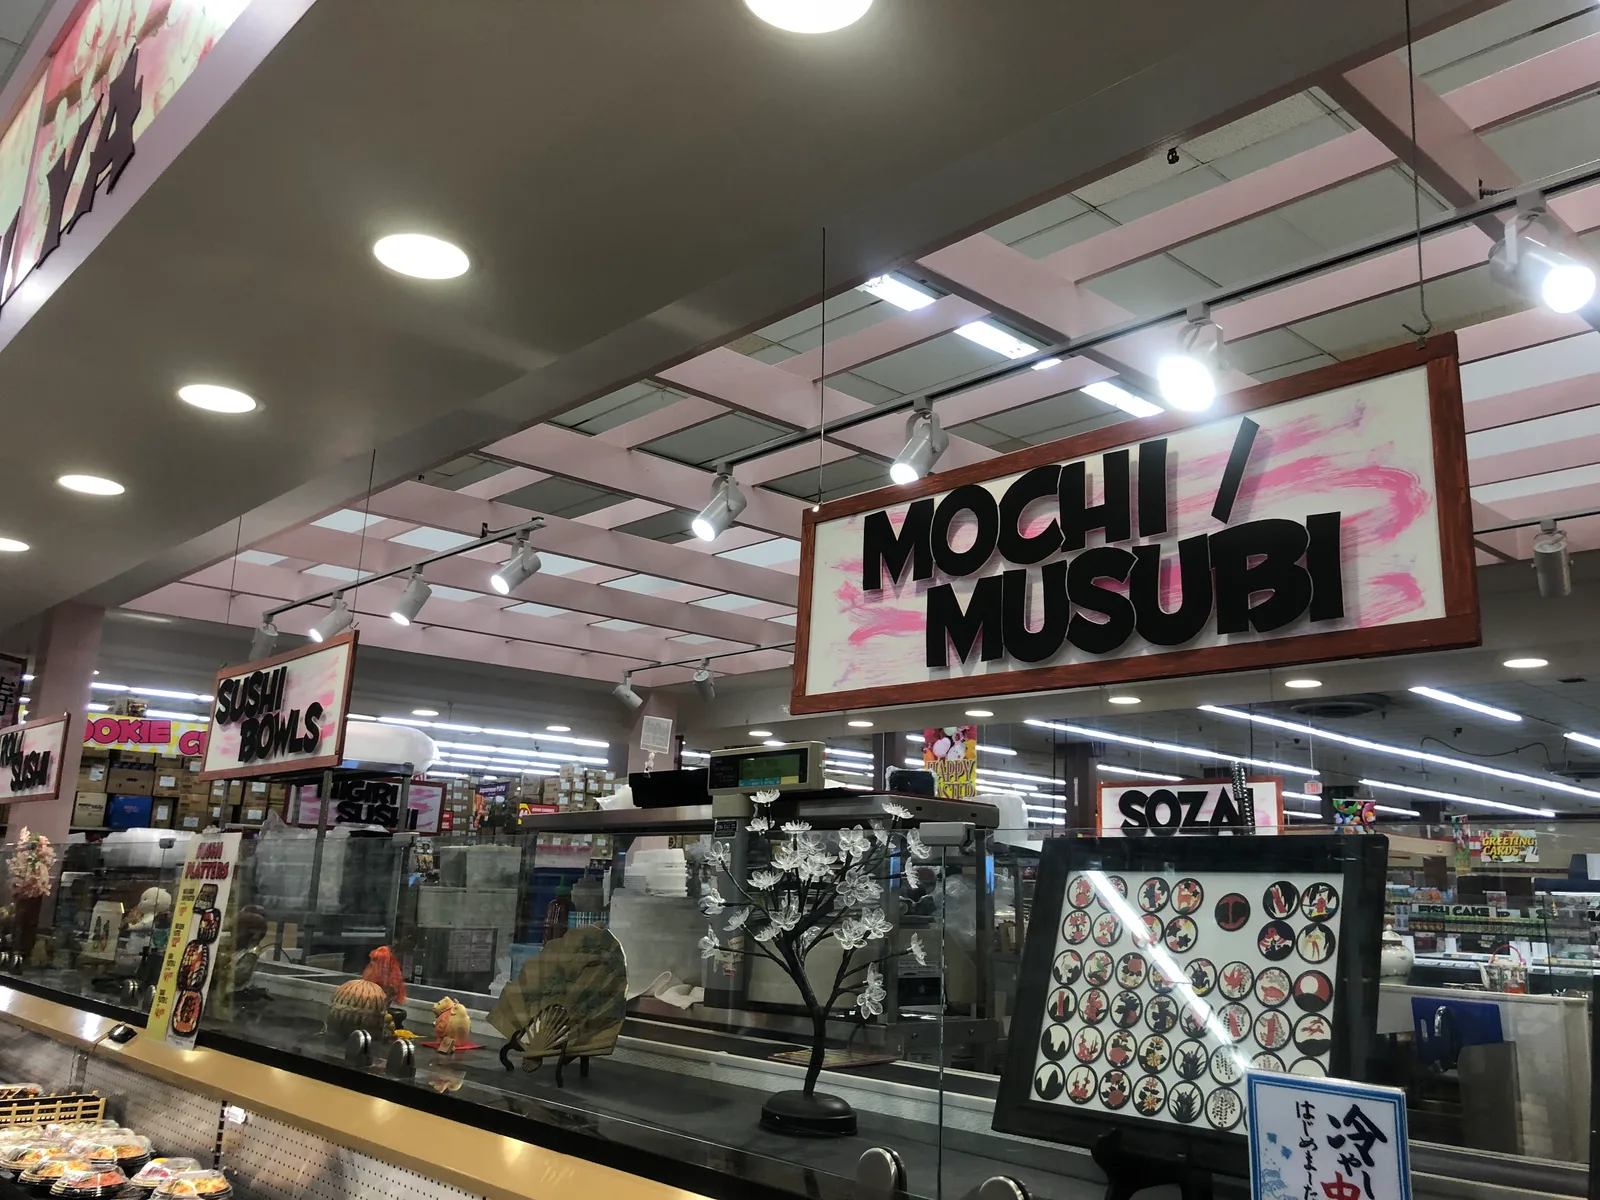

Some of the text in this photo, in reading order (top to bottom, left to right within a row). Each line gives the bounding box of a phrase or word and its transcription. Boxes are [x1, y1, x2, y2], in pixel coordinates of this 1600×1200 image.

[862, 438, 1168, 591] MOCHI
[925, 511, 1345, 668] MUSUBI
[215, 666, 287, 725] SUSHI
[238, 702, 324, 763] BOWLS
[927, 760, 976, 783] HAPPY
[1482, 836, 1535, 847] GREETING
[1483, 846, 1519, 857] CARDS
[1452, 906, 1490, 917] CAKE
